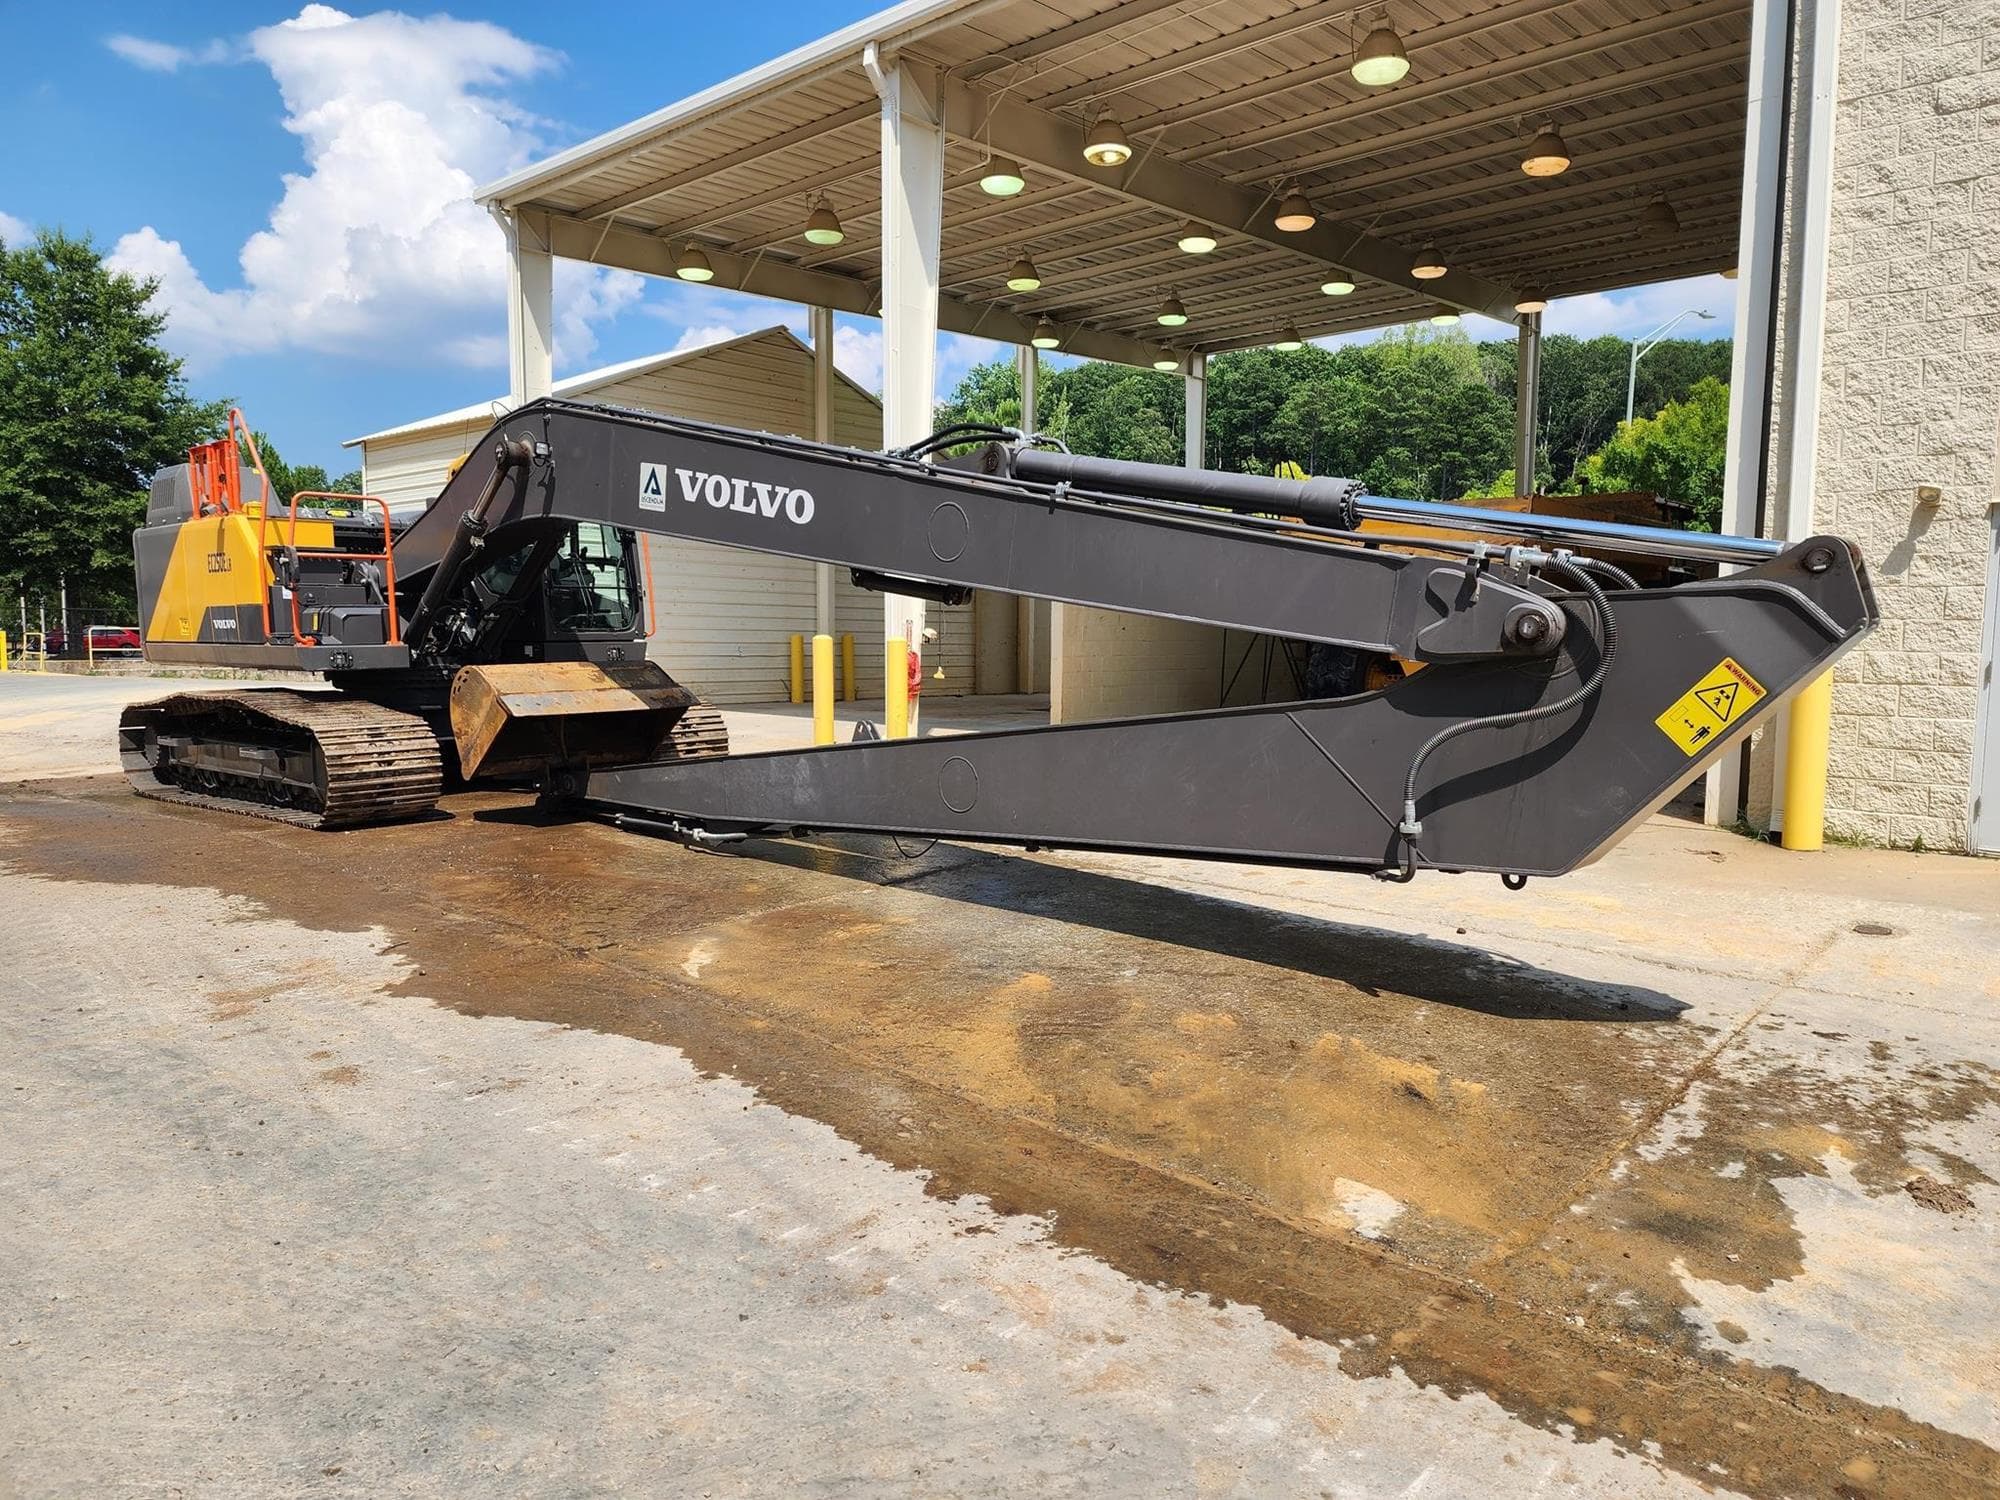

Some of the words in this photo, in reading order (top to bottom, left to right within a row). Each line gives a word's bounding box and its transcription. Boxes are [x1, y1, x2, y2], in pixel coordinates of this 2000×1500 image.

[675, 468, 815, 525] VOLVO
[213, 619, 236, 629] VOLVO
[1731, 667, 1761, 696] WARNING
